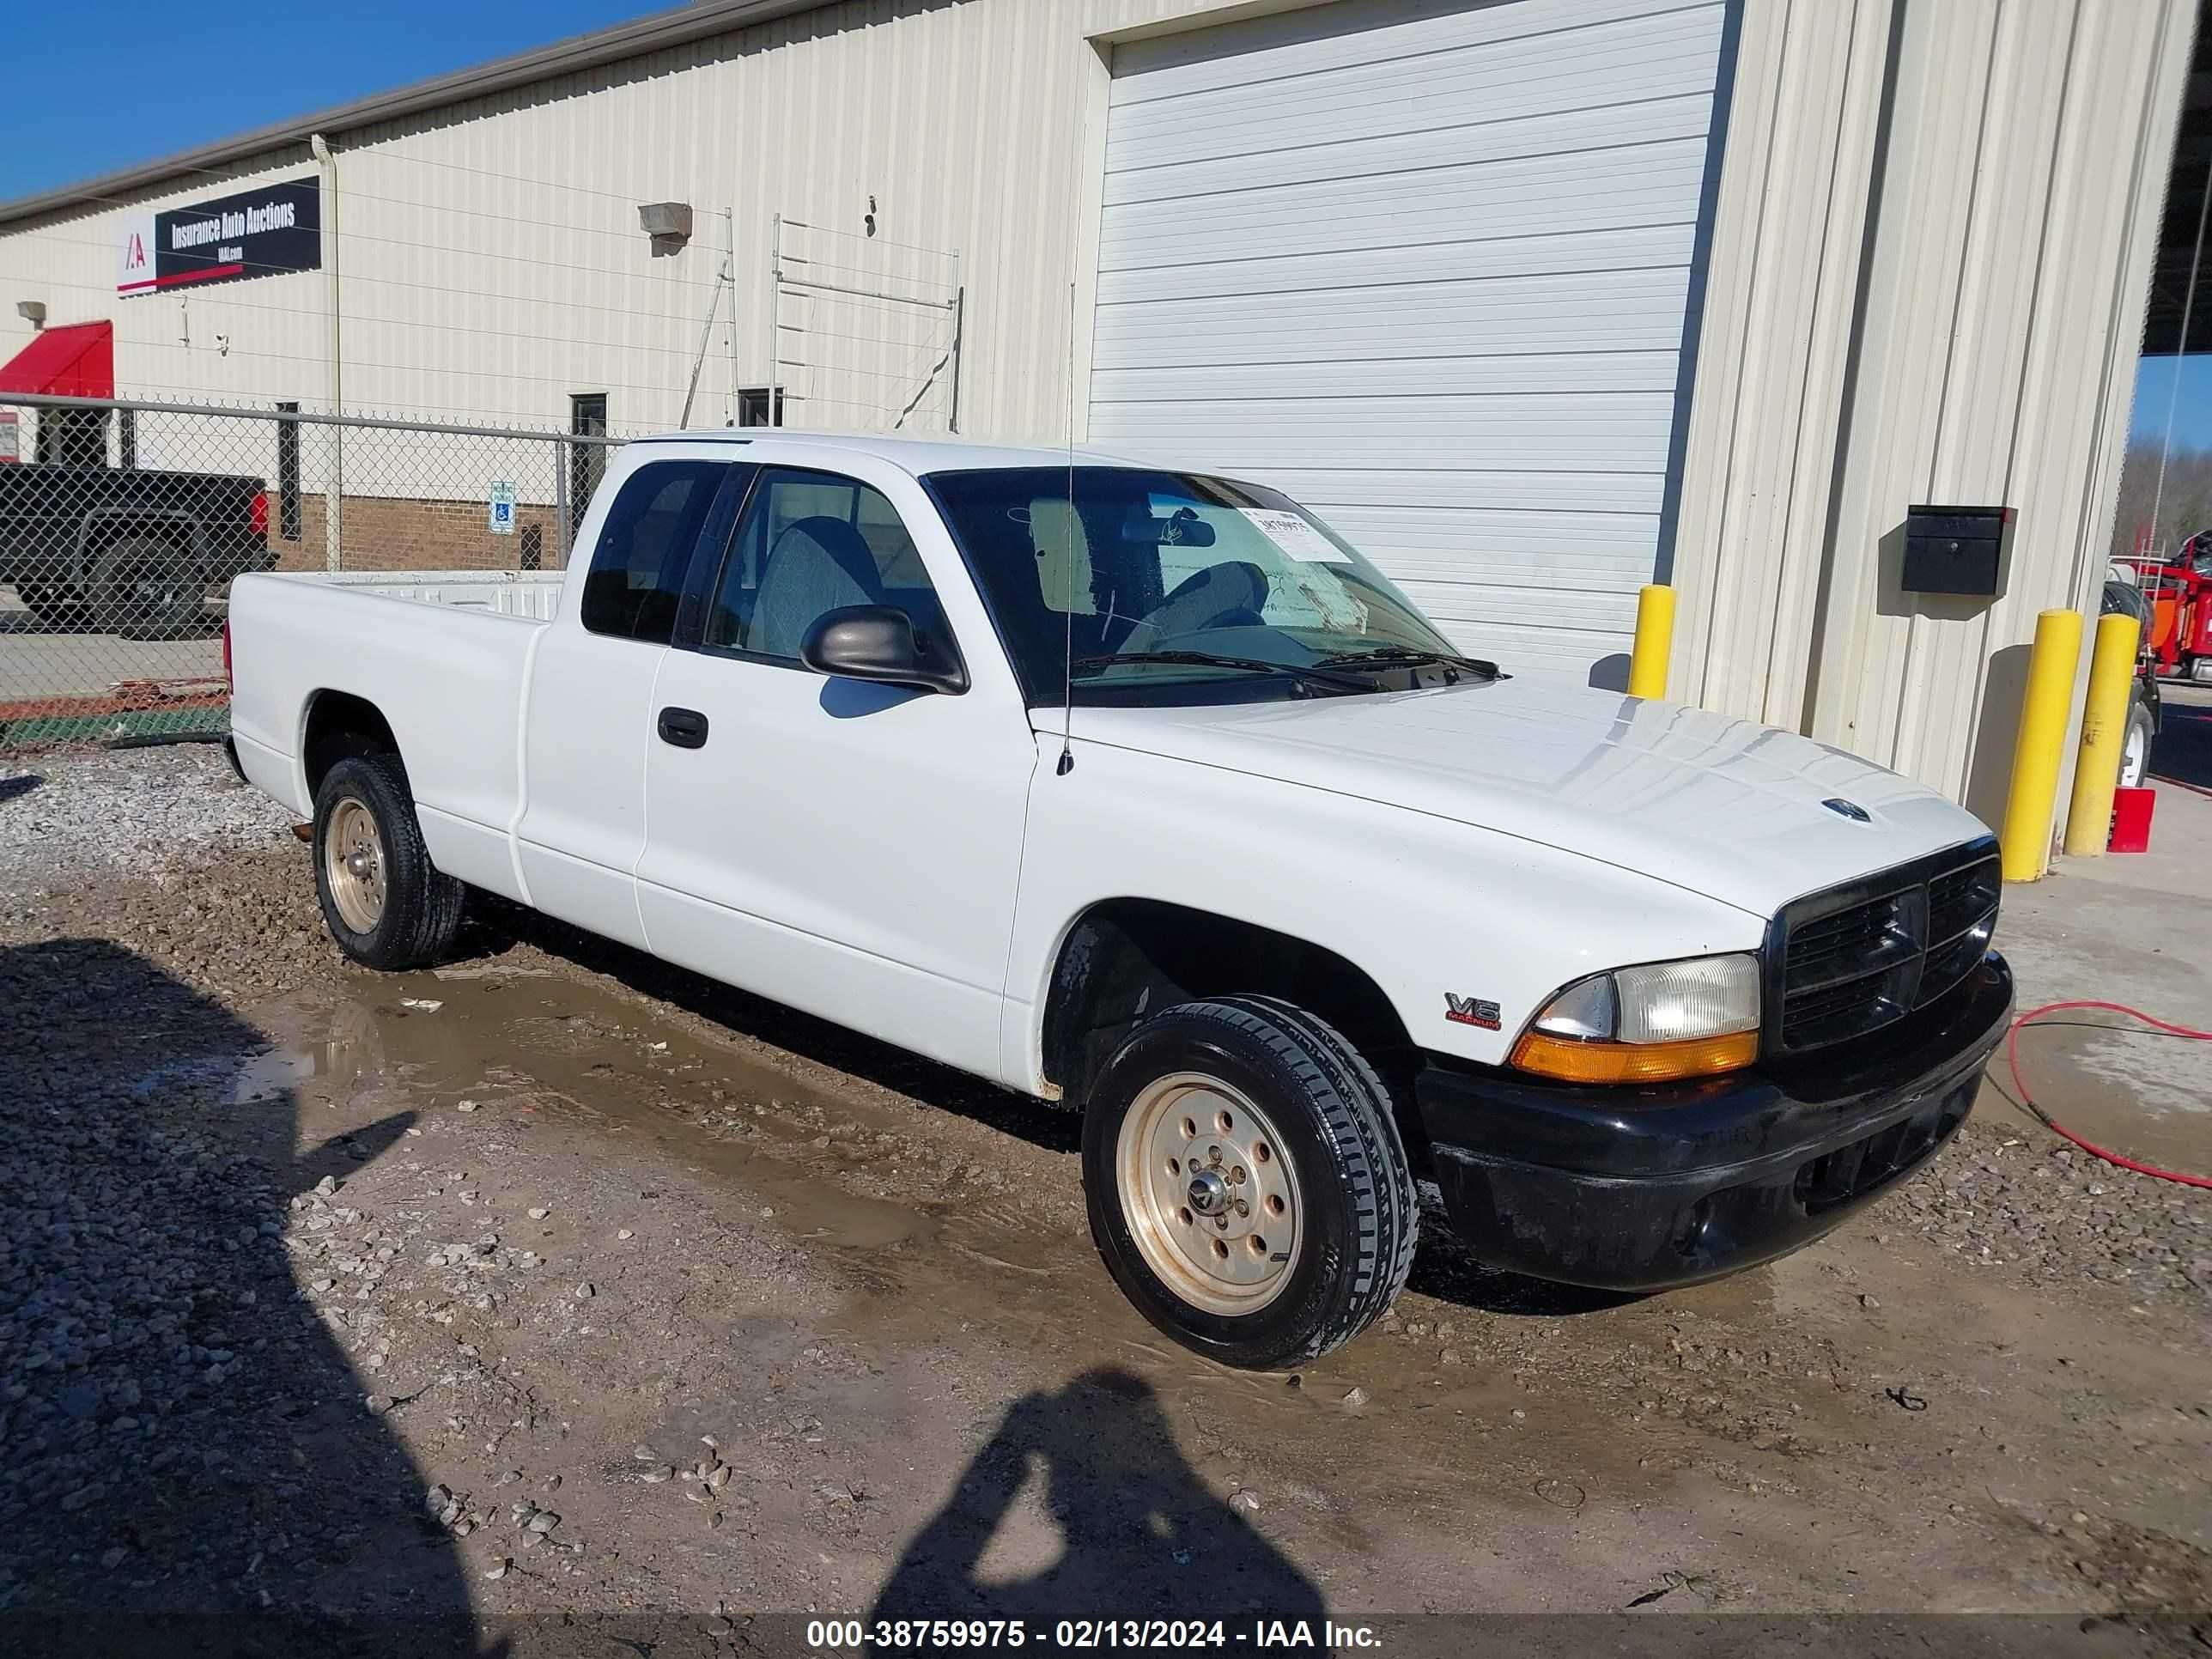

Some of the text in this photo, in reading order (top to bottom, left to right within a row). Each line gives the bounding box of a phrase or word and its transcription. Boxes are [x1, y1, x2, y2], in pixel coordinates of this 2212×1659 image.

[172, 202, 295, 250] Insurance Auto Auctions
[1443, 992, 1501, 1021] V6
[1448, 1012, 1499, 1030] MAGNUM
